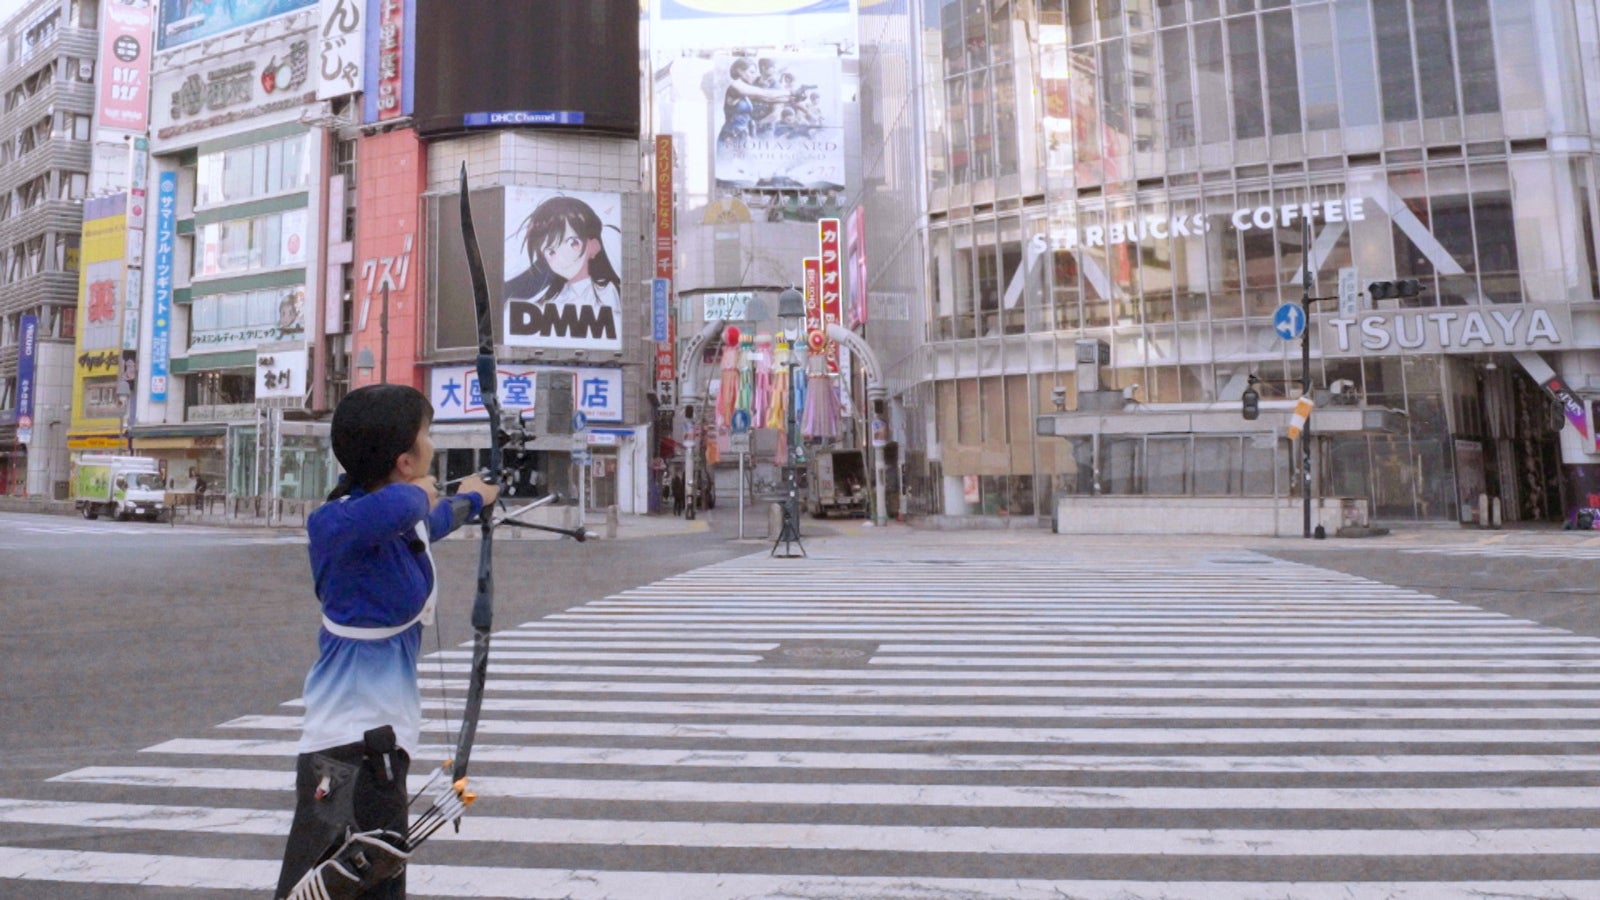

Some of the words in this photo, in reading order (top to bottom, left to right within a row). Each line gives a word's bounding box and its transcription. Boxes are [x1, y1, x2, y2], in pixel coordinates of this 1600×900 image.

[490, 112, 513, 123] DHC
[515, 111, 556, 123] Channel
[1032, 212, 1211, 253] STARBUCKS
[1231, 197, 1365, 231] COFFEE
[156, 196, 174, 314] サマーフルーツギフト
[822, 229, 838, 305] カラオケ
[509, 301, 617, 340] DMM
[1329, 309, 1562, 351] TSUTAYA
[440, 376, 608, 408] 大堂店
